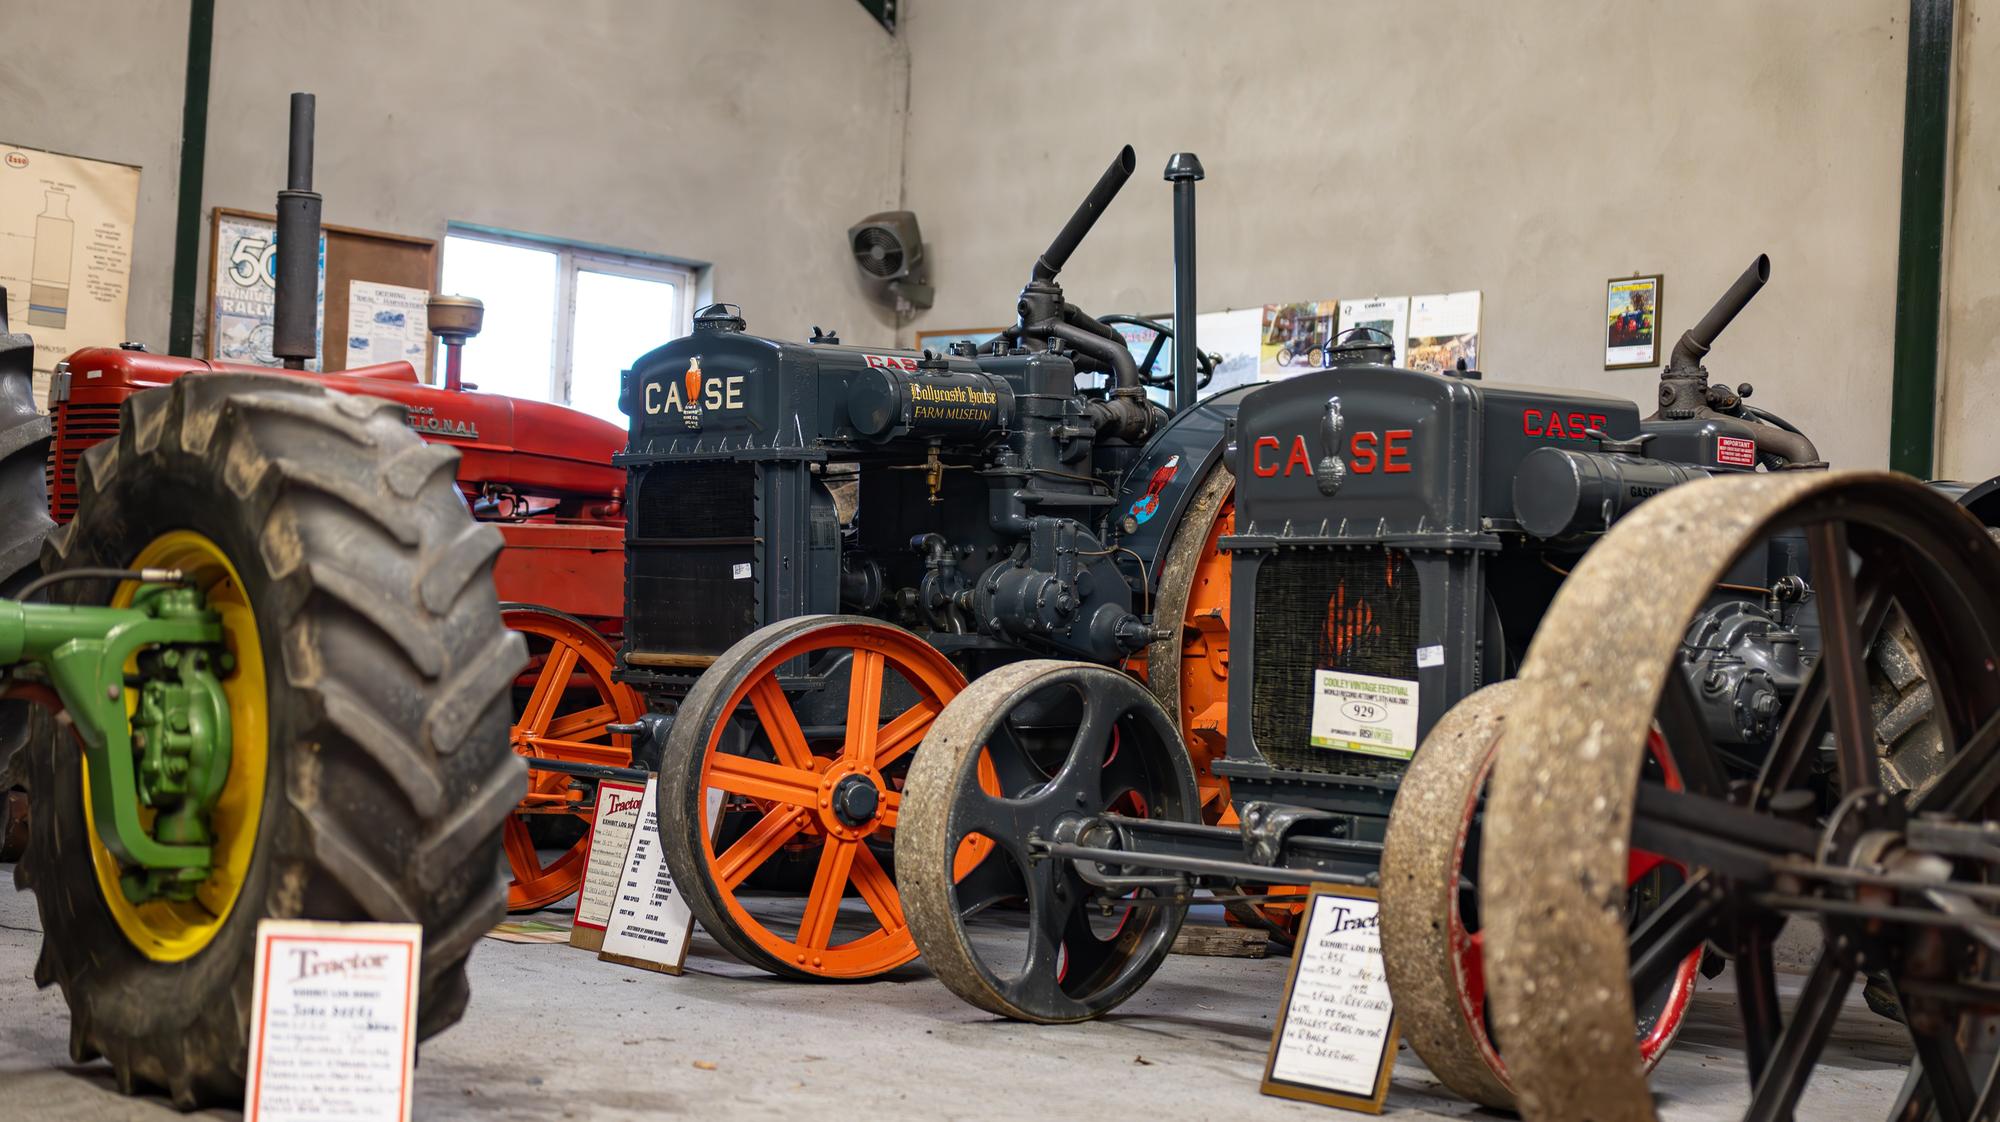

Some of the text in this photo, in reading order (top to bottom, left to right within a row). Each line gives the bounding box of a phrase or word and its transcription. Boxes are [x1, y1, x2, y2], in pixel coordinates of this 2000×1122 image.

[9, 155, 27, 165] Esso
[220, 287, 275, 304] ANNIVE
[223, 299, 273, 317] RALLY
[866, 355, 918, 371] CAS
[909, 383, 966, 403] Ballycastle
[914, 406, 992, 420] FARM MUSEUM
[408, 415, 479, 435] TIONAL
[1523, 409, 1607, 439] CASE
[1724, 440, 1750, 449] IMPORTANT
[1631, 486, 1665, 498] GASO
[1323, 677, 1409, 697] COOLEY VINTAGE FESTIVAL
[1354, 704, 1375, 718] 929
[603, 819, 618, 827] EXHIBIT
[1326, 907, 1379, 936] Tract
[1320, 940, 1349, 951] EXHIBIT
[288, 948, 389, 983] Tractor
